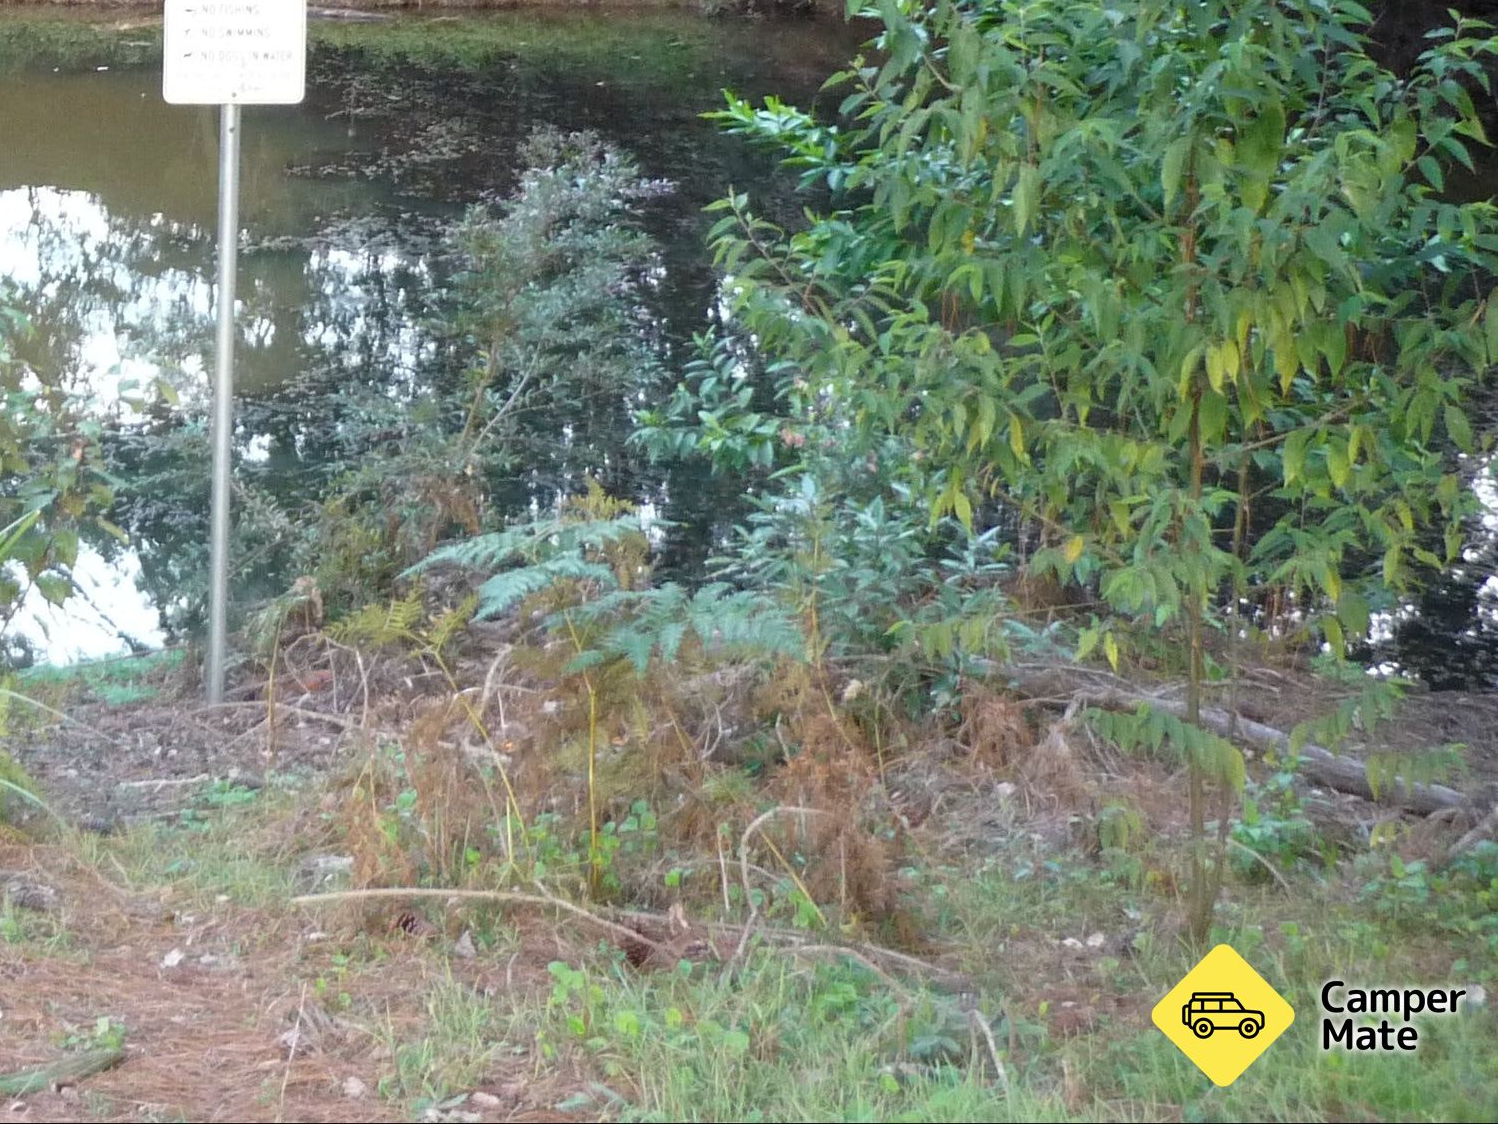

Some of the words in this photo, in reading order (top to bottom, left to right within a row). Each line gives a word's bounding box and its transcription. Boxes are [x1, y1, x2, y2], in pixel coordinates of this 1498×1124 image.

[201, 4, 216, 15] NO
[201, 26, 216, 38] NO
[219, 26, 270, 38] SWIMMING
[201, 50, 215, 61] NO
